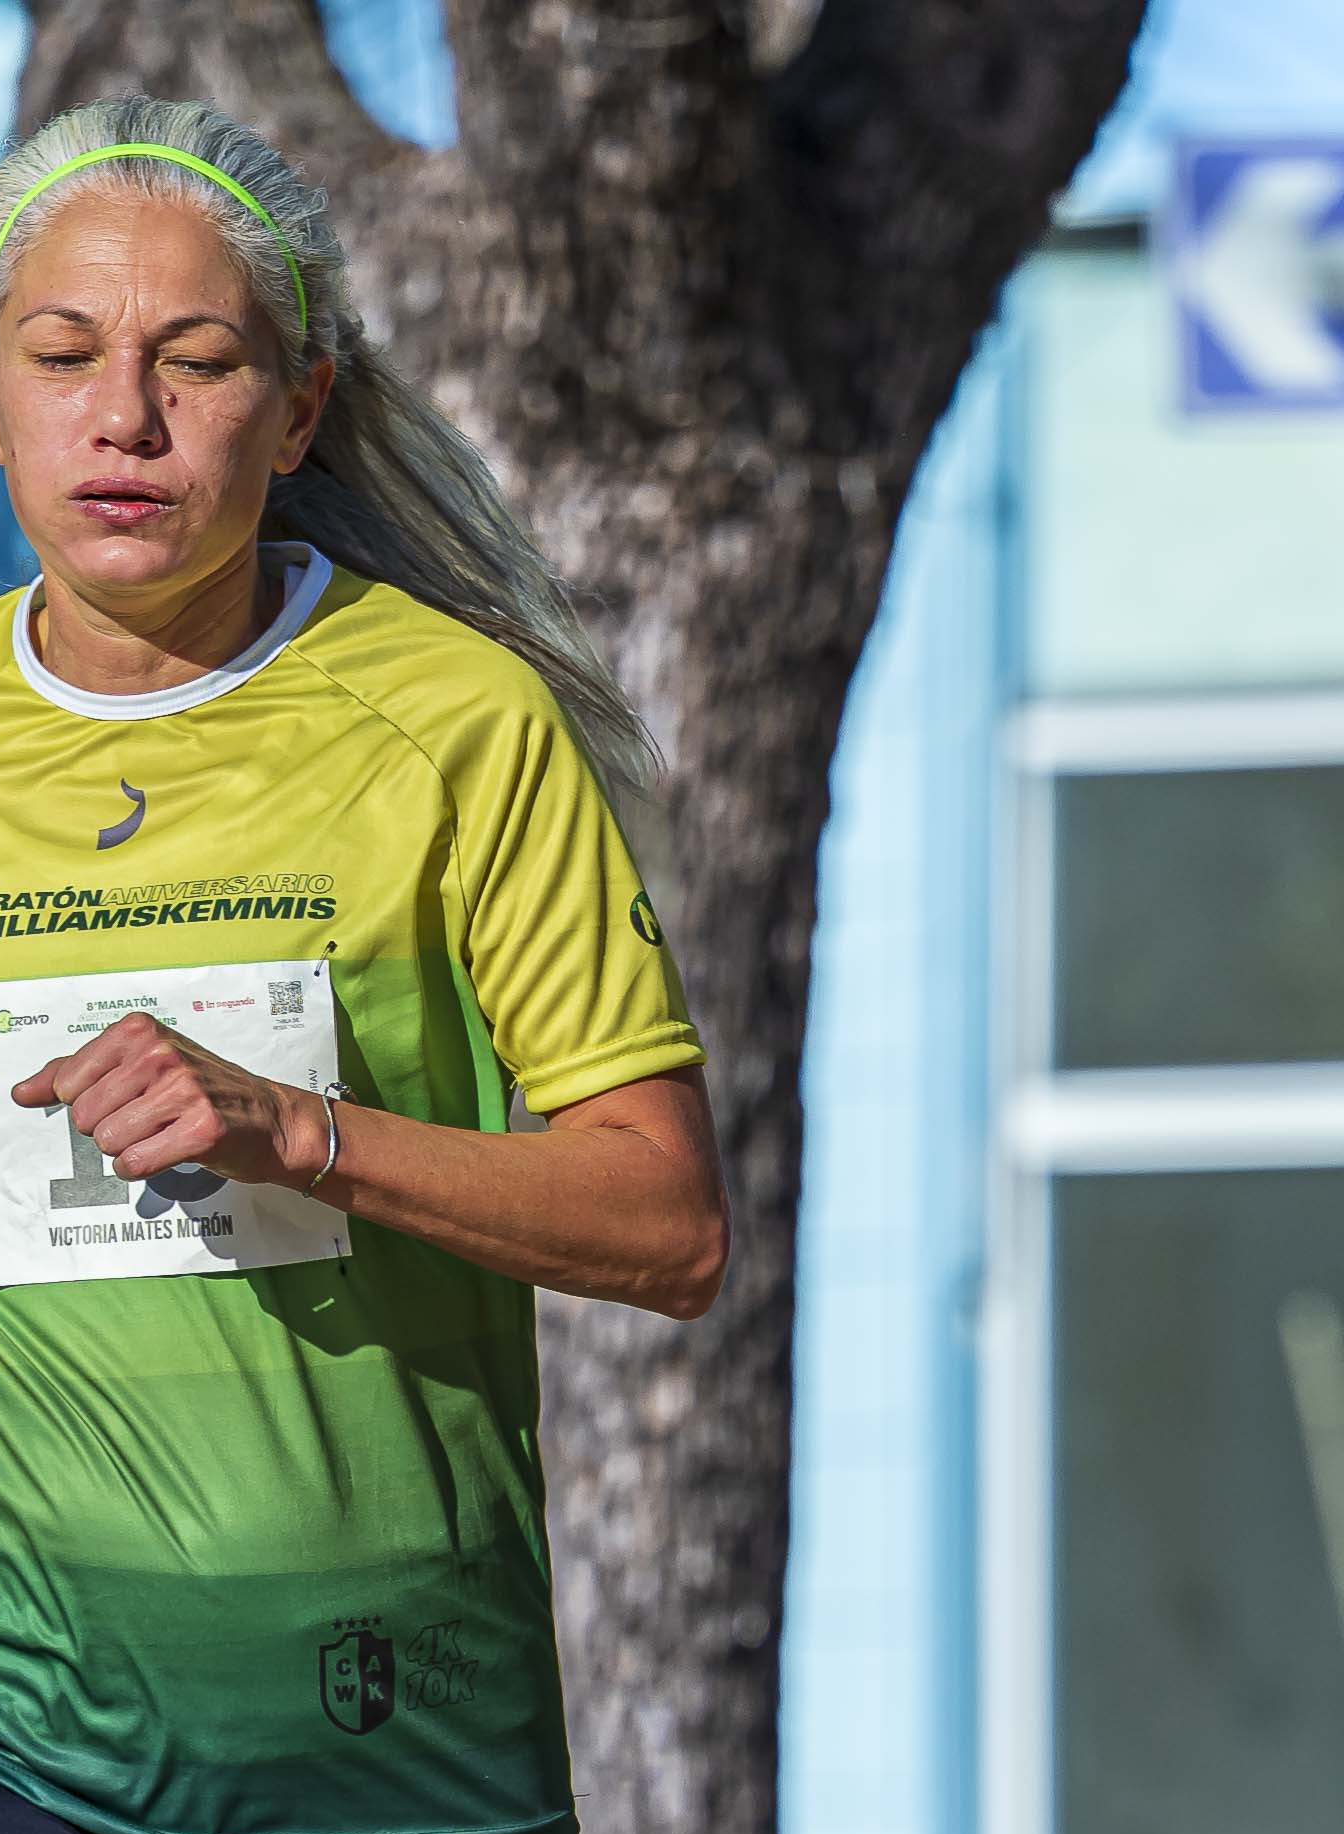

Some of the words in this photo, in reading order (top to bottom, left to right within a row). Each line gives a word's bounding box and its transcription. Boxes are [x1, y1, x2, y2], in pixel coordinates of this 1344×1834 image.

[100, 873, 334, 907] ANIVERSARIO
[49, 1223, 118, 1247] VICTORIA
[121, 1218, 173, 1243] MATES
[176, 1211, 234, 1239] MORÓN
